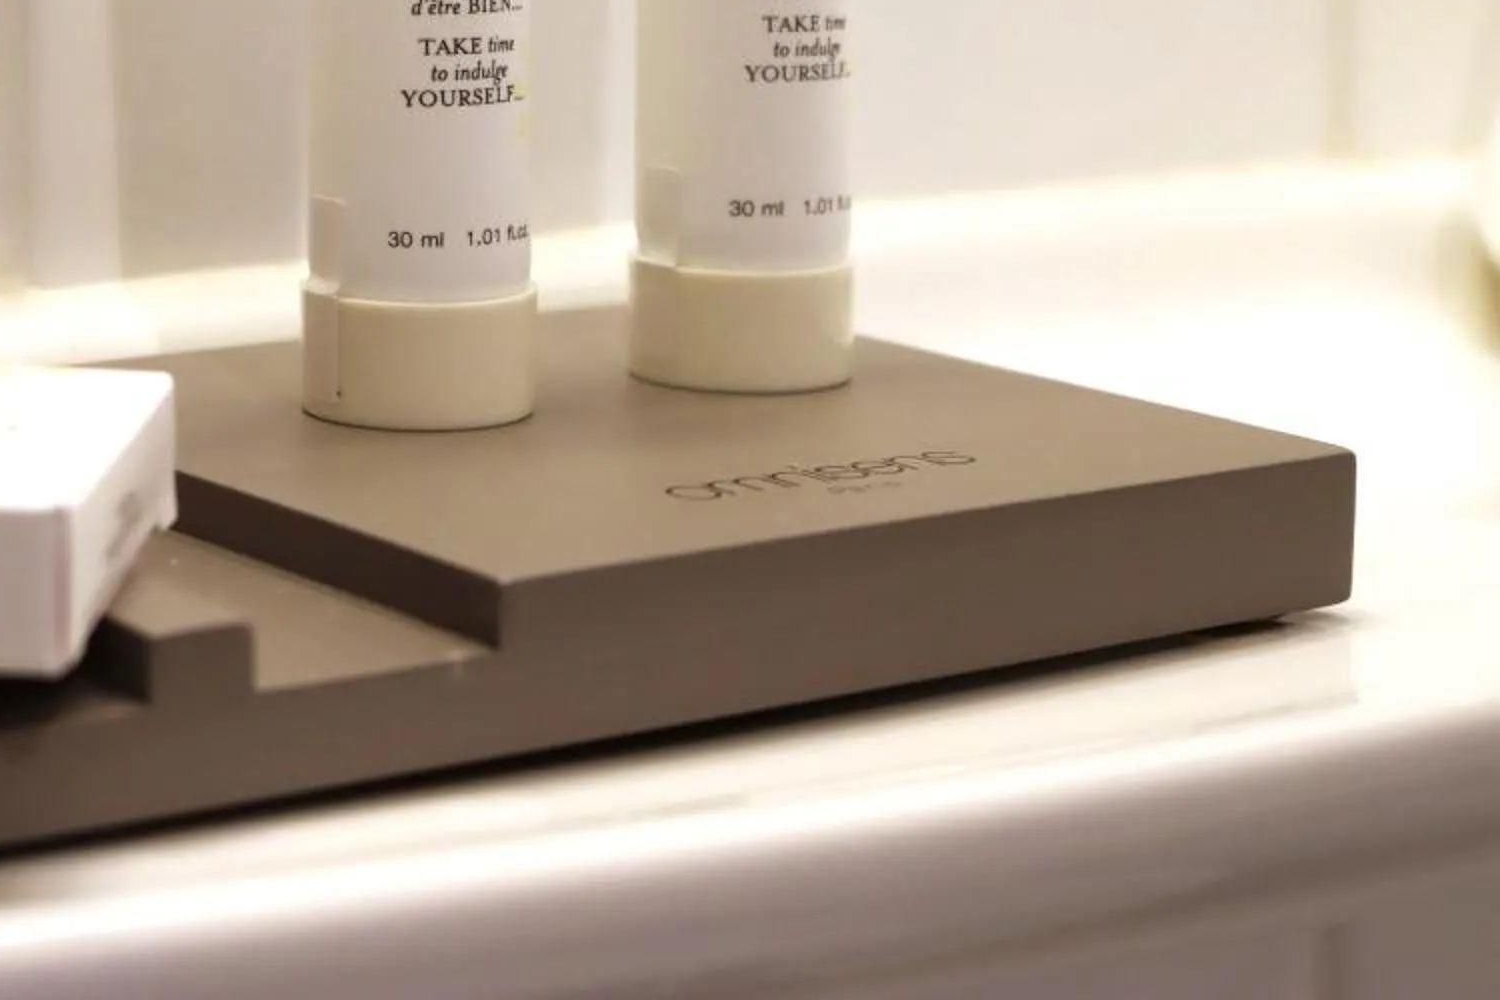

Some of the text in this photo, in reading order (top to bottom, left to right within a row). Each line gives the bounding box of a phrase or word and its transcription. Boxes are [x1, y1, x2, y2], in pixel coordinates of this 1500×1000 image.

[762, 14, 821, 33] TAKE
[417, 37, 482, 56] TAKE
[773, 41, 790, 58] to
[431, 64, 449, 82] to
[728, 199, 755, 218] 30
[761, 200, 786, 217] ml
[387, 231, 414, 250] 30
[420, 231, 446, 249] ml
[467, 228, 501, 247] 1.01
